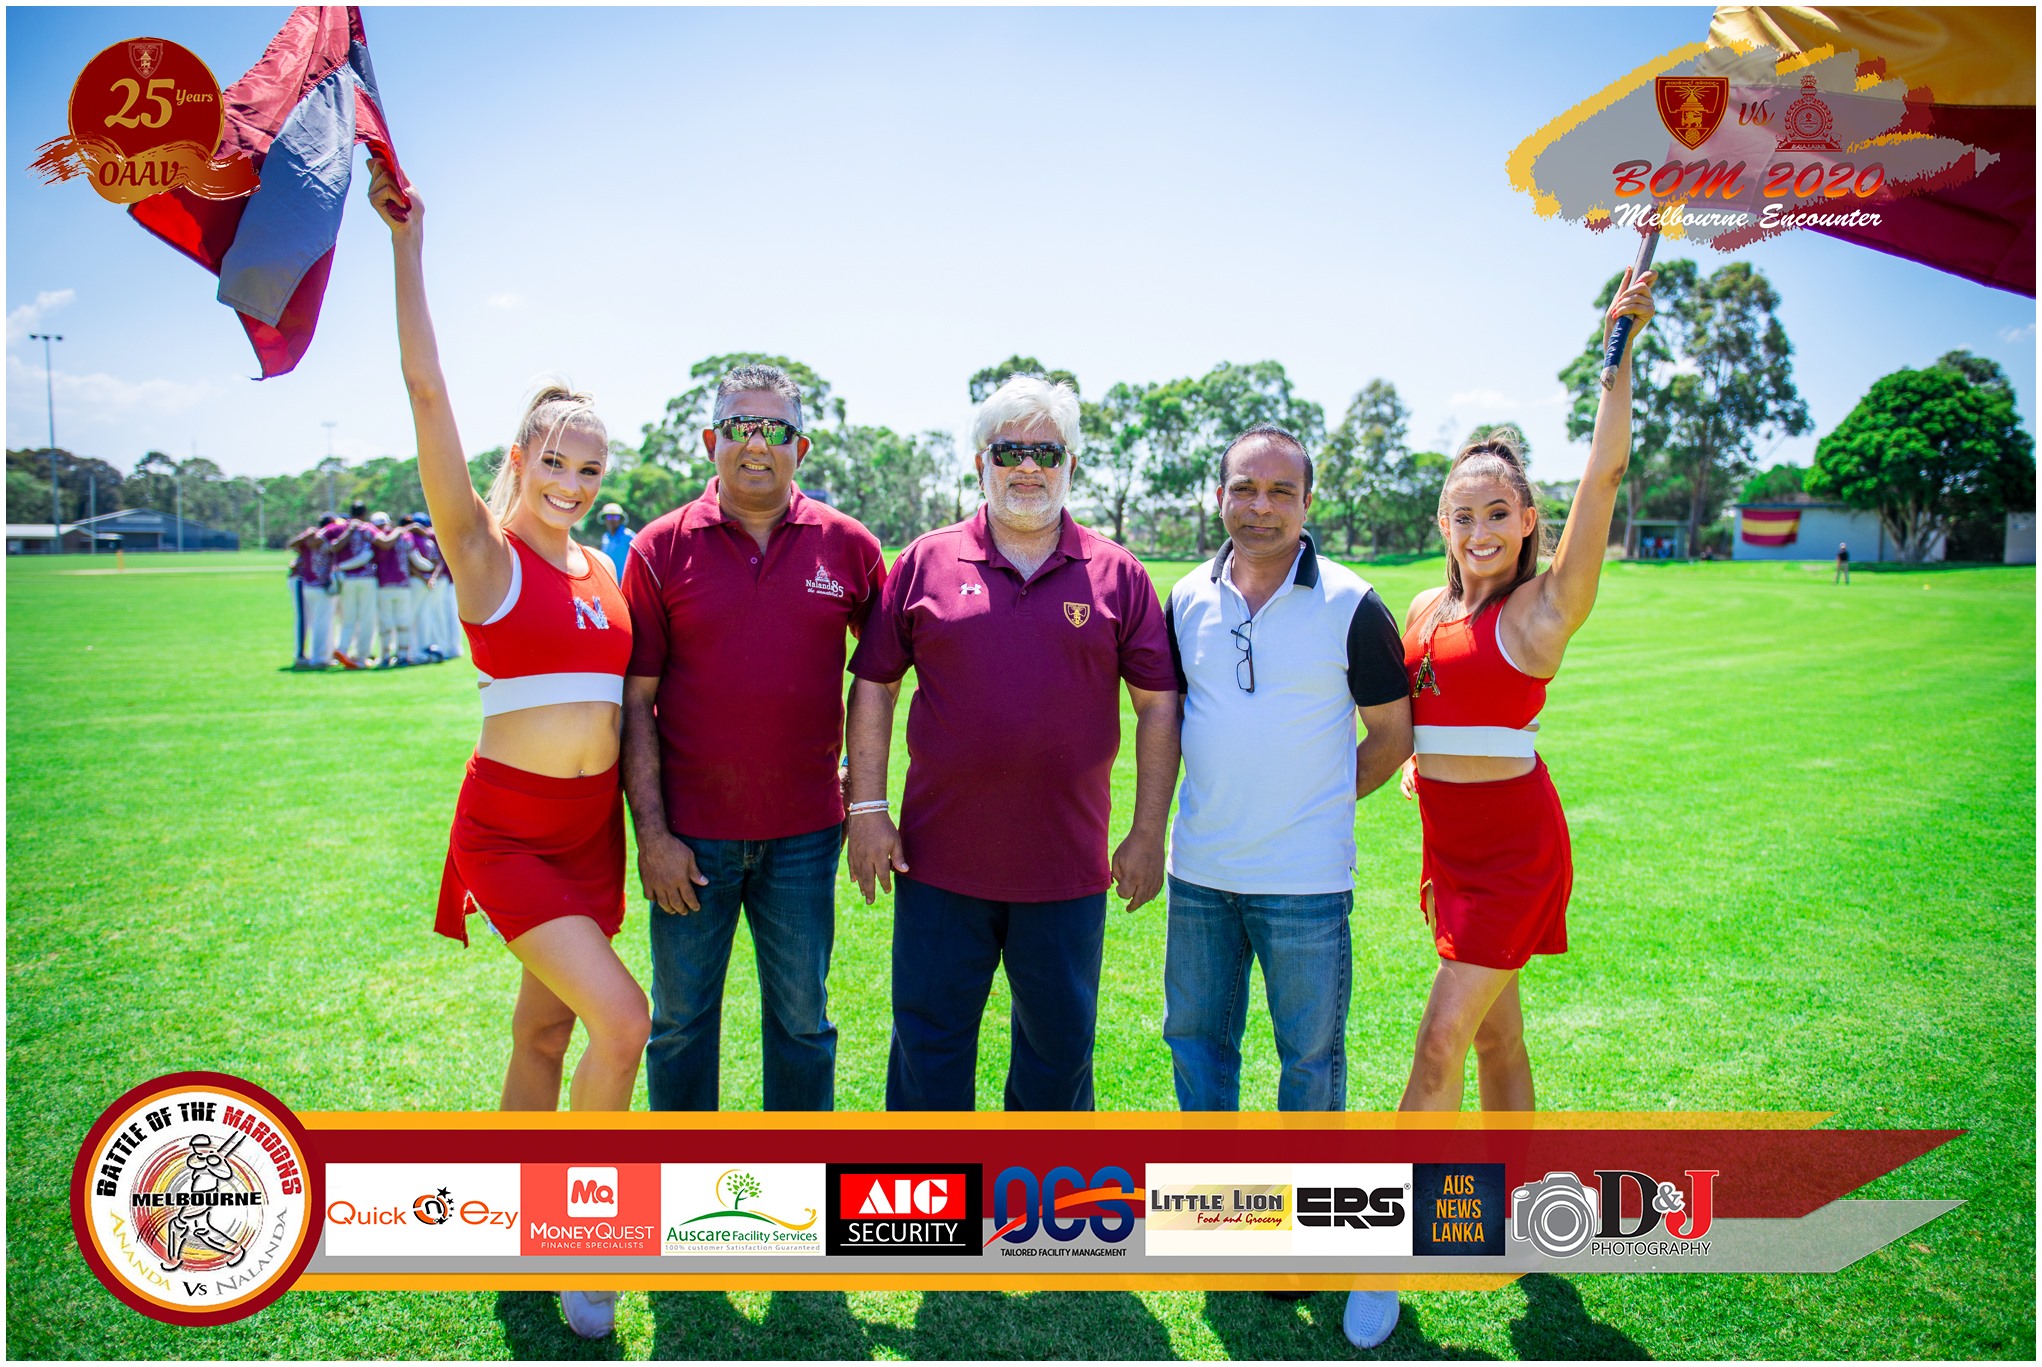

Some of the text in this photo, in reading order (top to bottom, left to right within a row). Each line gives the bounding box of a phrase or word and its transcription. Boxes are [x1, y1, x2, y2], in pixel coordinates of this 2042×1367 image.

[831, 580, 844, 598] 85
[573, 596, 610, 630] N
[1412, 655, 1441, 698] A
